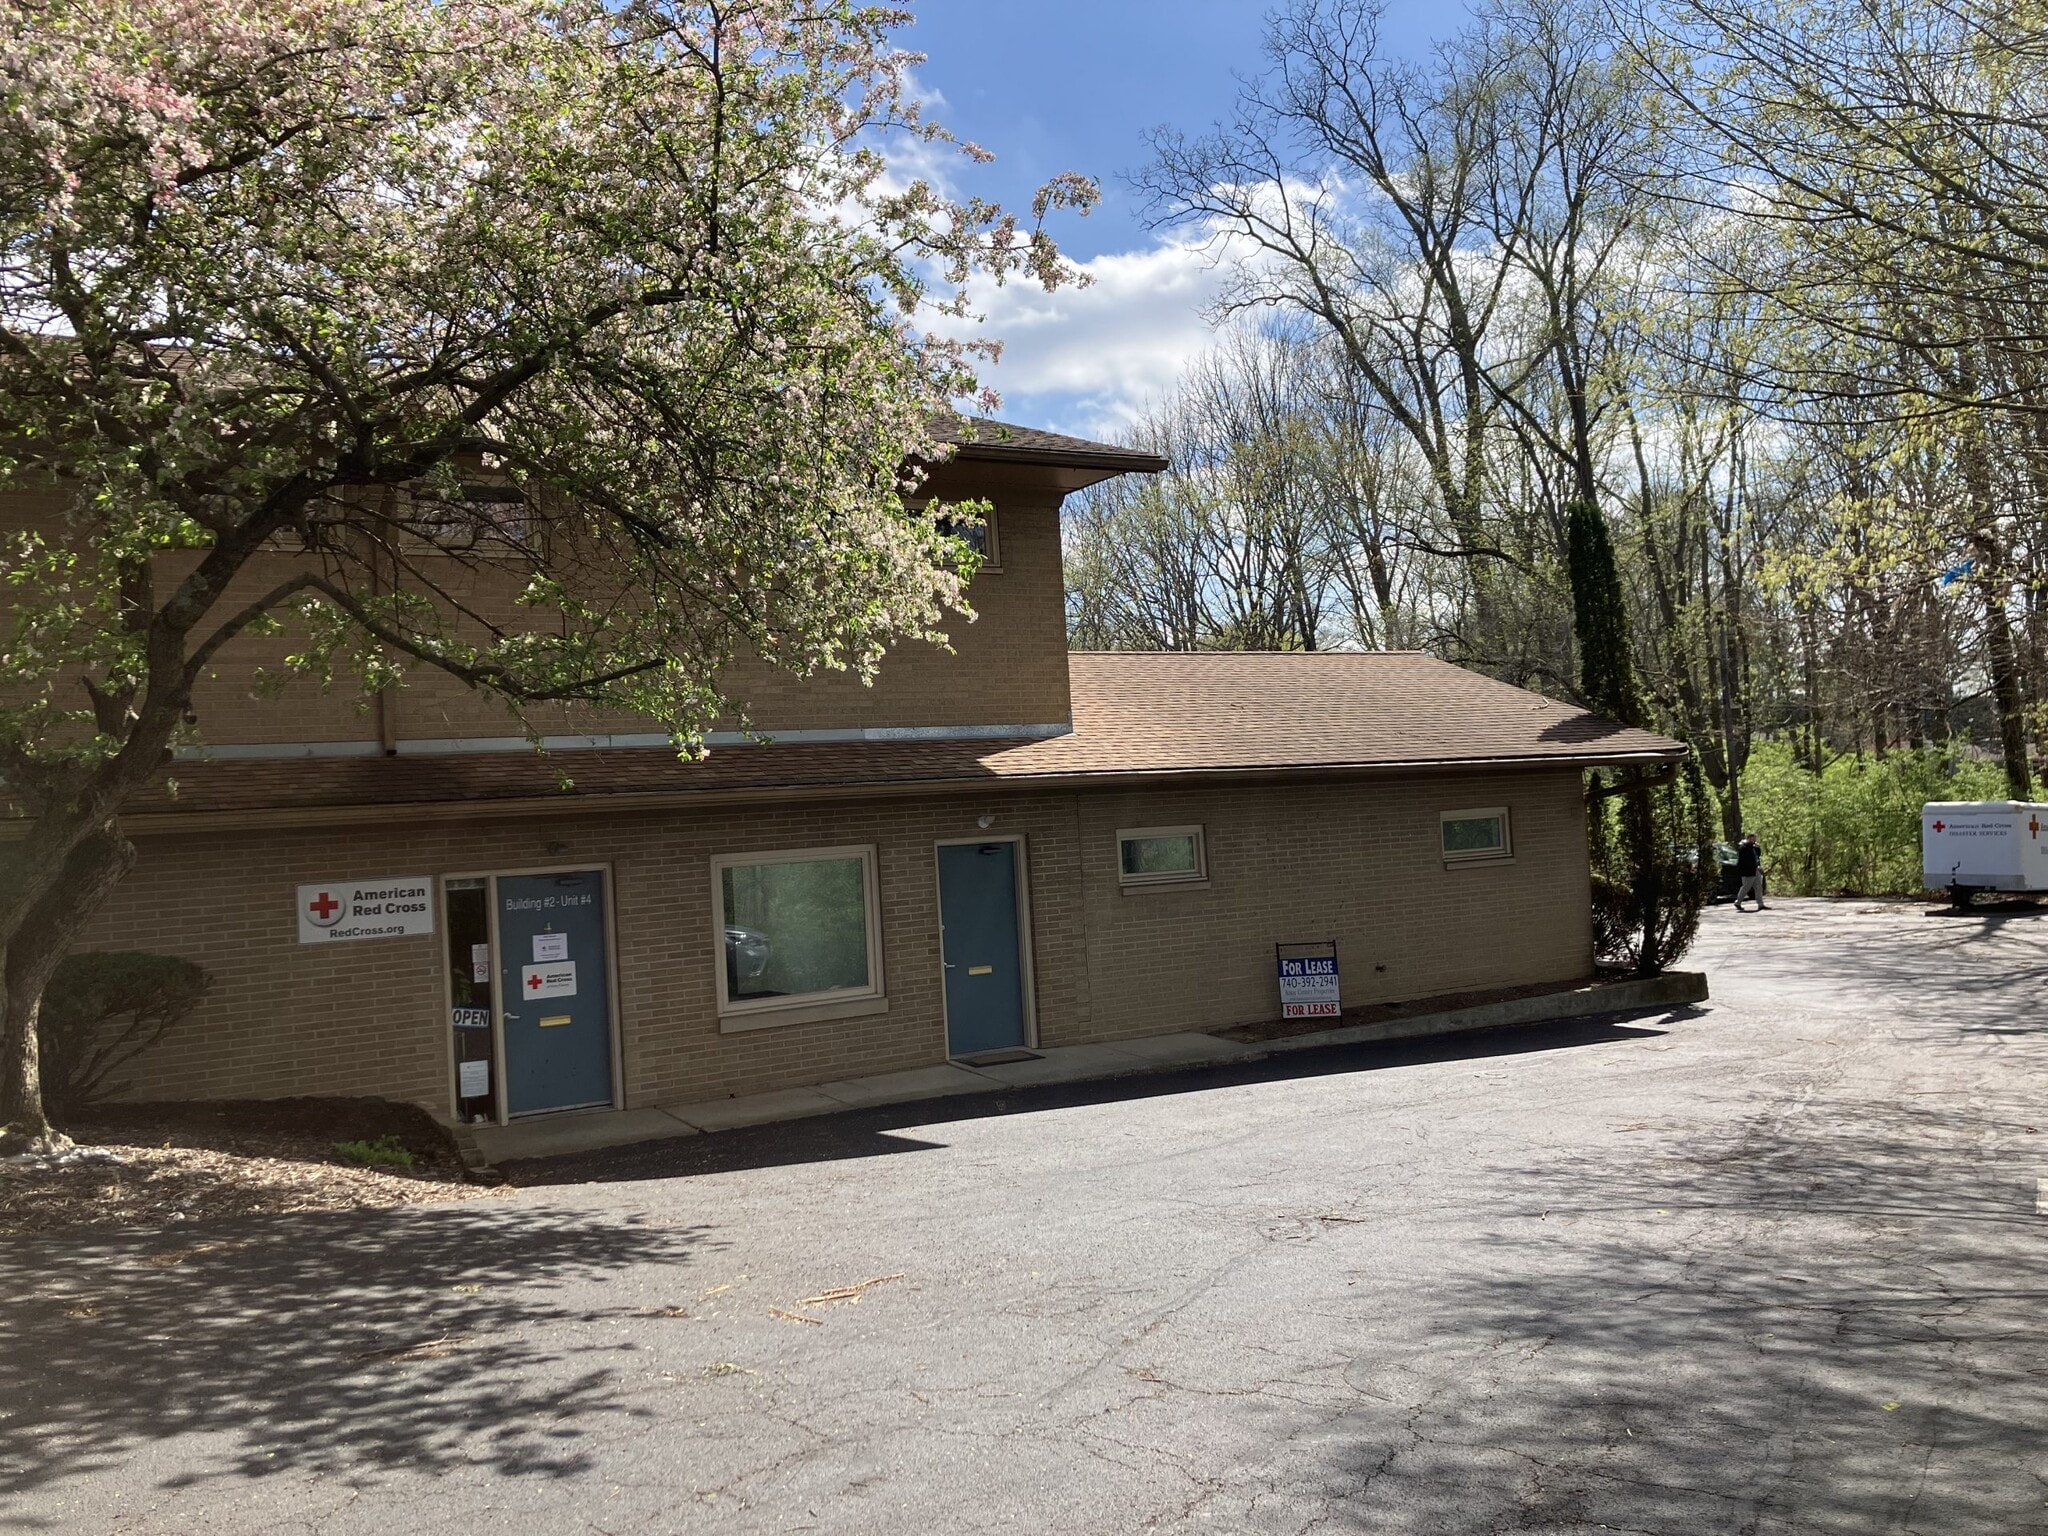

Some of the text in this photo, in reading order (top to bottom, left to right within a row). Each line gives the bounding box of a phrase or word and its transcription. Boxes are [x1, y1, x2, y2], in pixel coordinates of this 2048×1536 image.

[353, 887, 425, 901] American
[506, 897, 542, 911] Building
[580, 893, 592, 905] #4
[353, 902, 426, 917] Red Cross
[330, 925, 404, 938] RedCross.org
[1281, 976, 1337, 989] 740-392-2941
[1286, 1003, 1337, 1016] FOR LEASE
[453, 1010, 488, 1025] OPEN
